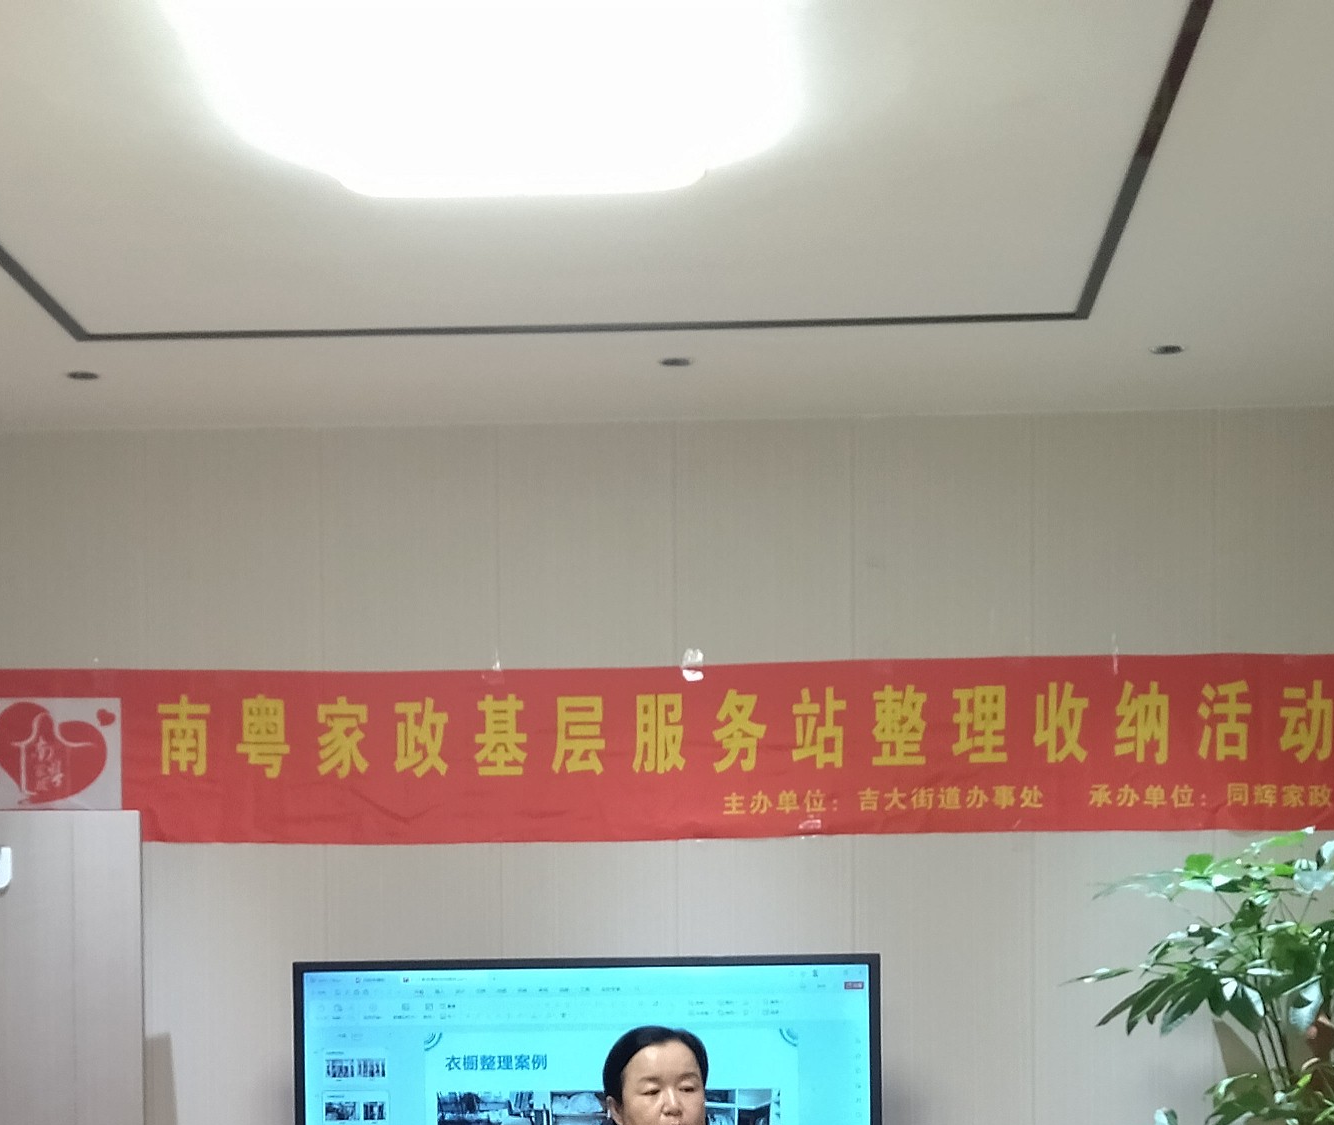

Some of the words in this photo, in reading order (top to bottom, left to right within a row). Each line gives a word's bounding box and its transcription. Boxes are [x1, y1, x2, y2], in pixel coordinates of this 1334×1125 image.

[157, 679, 1334, 778] 南粤家政基层服务站整理收纳活动
[445, 1055, 548, 1071] 衣橱整理案例
